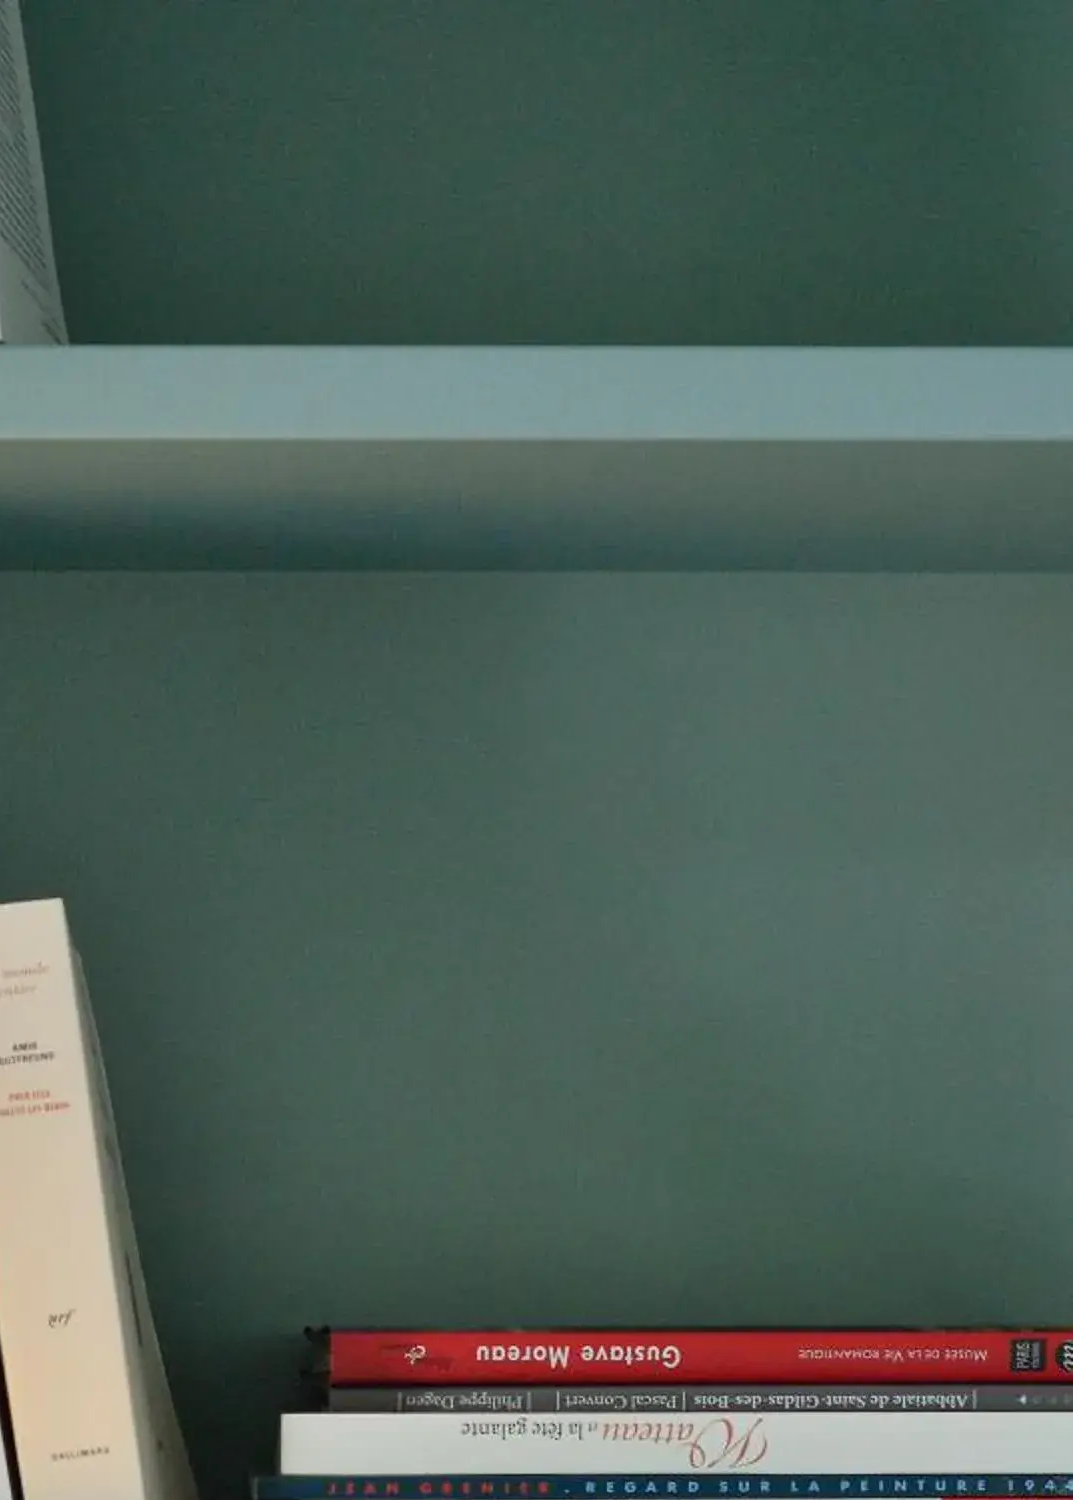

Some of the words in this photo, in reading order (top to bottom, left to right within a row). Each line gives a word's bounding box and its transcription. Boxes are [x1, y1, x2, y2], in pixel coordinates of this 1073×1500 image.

[476, 1345, 569, 1369] Moreau
[580, 1345, 681, 1369] Gustave
[459, 1391, 523, 1408] Philippe
[564, 1392, 628, 1408] Convert
[631, 1392, 677, 1408] Pascal
[695, 1393, 866, 1409] Saint-Gildas-des-Bois
[870, 1394, 886, 1408] de
[889, 1394, 969, 1408] Abbatiale
[461, 1417, 526, 1440] galante
[532, 1422, 564, 1441] fête
[568, 1422, 584, 1441] la
[602, 1418, 767, 1468] Watteau
[327, 1480, 399, 1495] JEAN
[585, 1480, 700, 1494] REGARD
[719, 1480, 770, 1493] SUR
[791, 1480, 820, 1492] LA
[840, 1480, 987, 1492] PEINTURE
